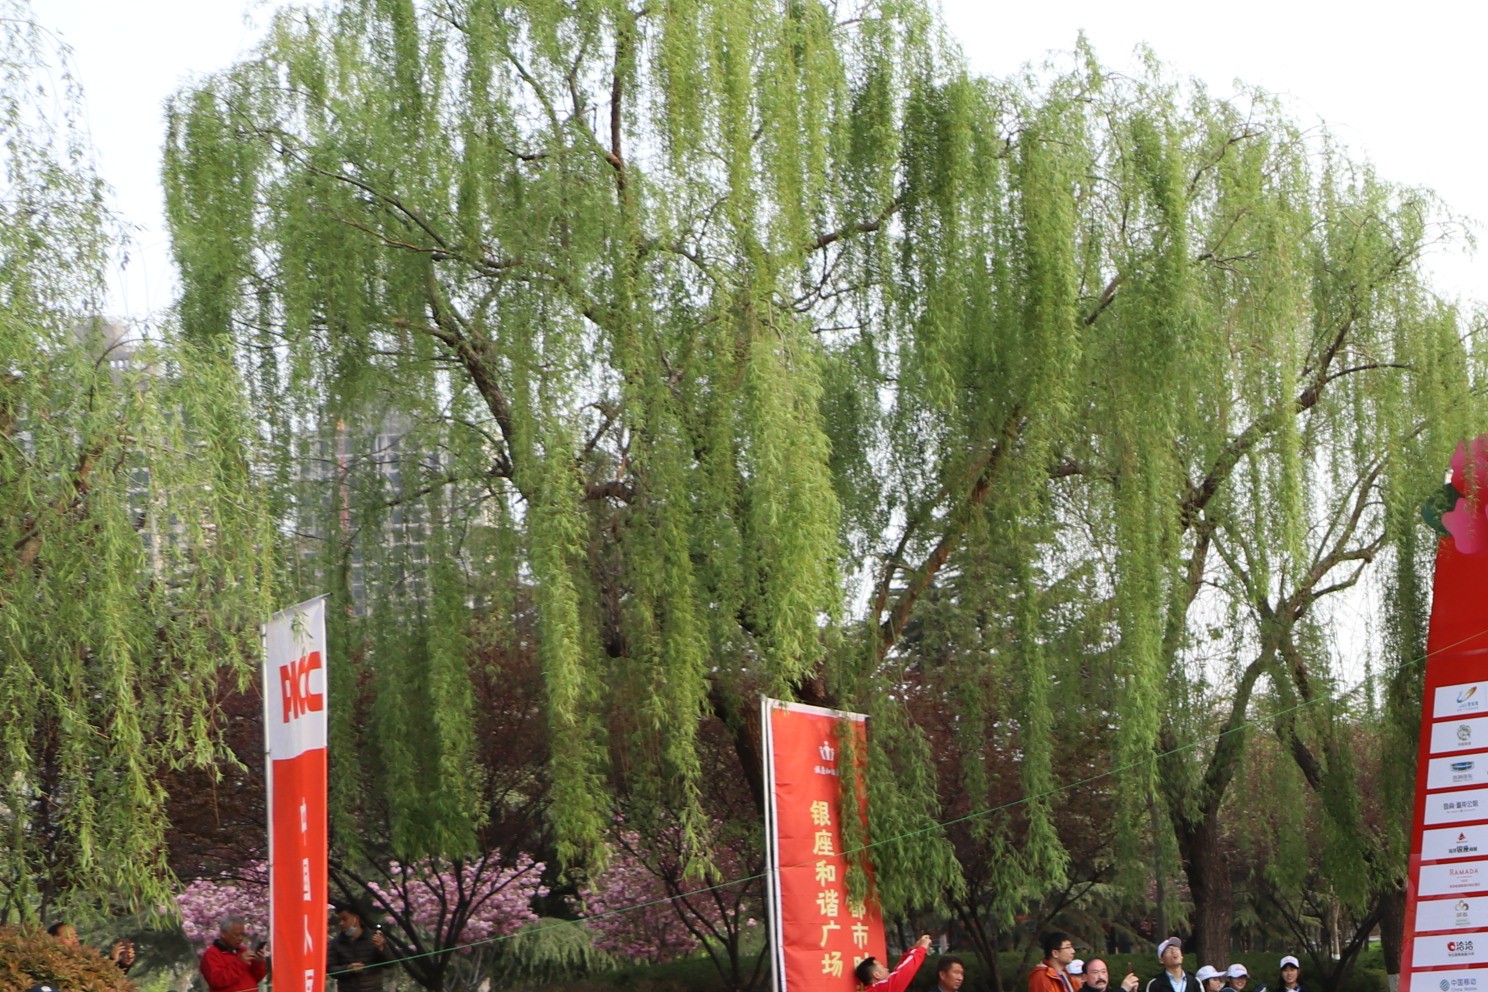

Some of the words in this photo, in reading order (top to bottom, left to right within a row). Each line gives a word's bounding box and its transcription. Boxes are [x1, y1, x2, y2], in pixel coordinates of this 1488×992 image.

[280, 652, 323, 723] PICC
[810, 800, 843, 977] 银座和谐广场
